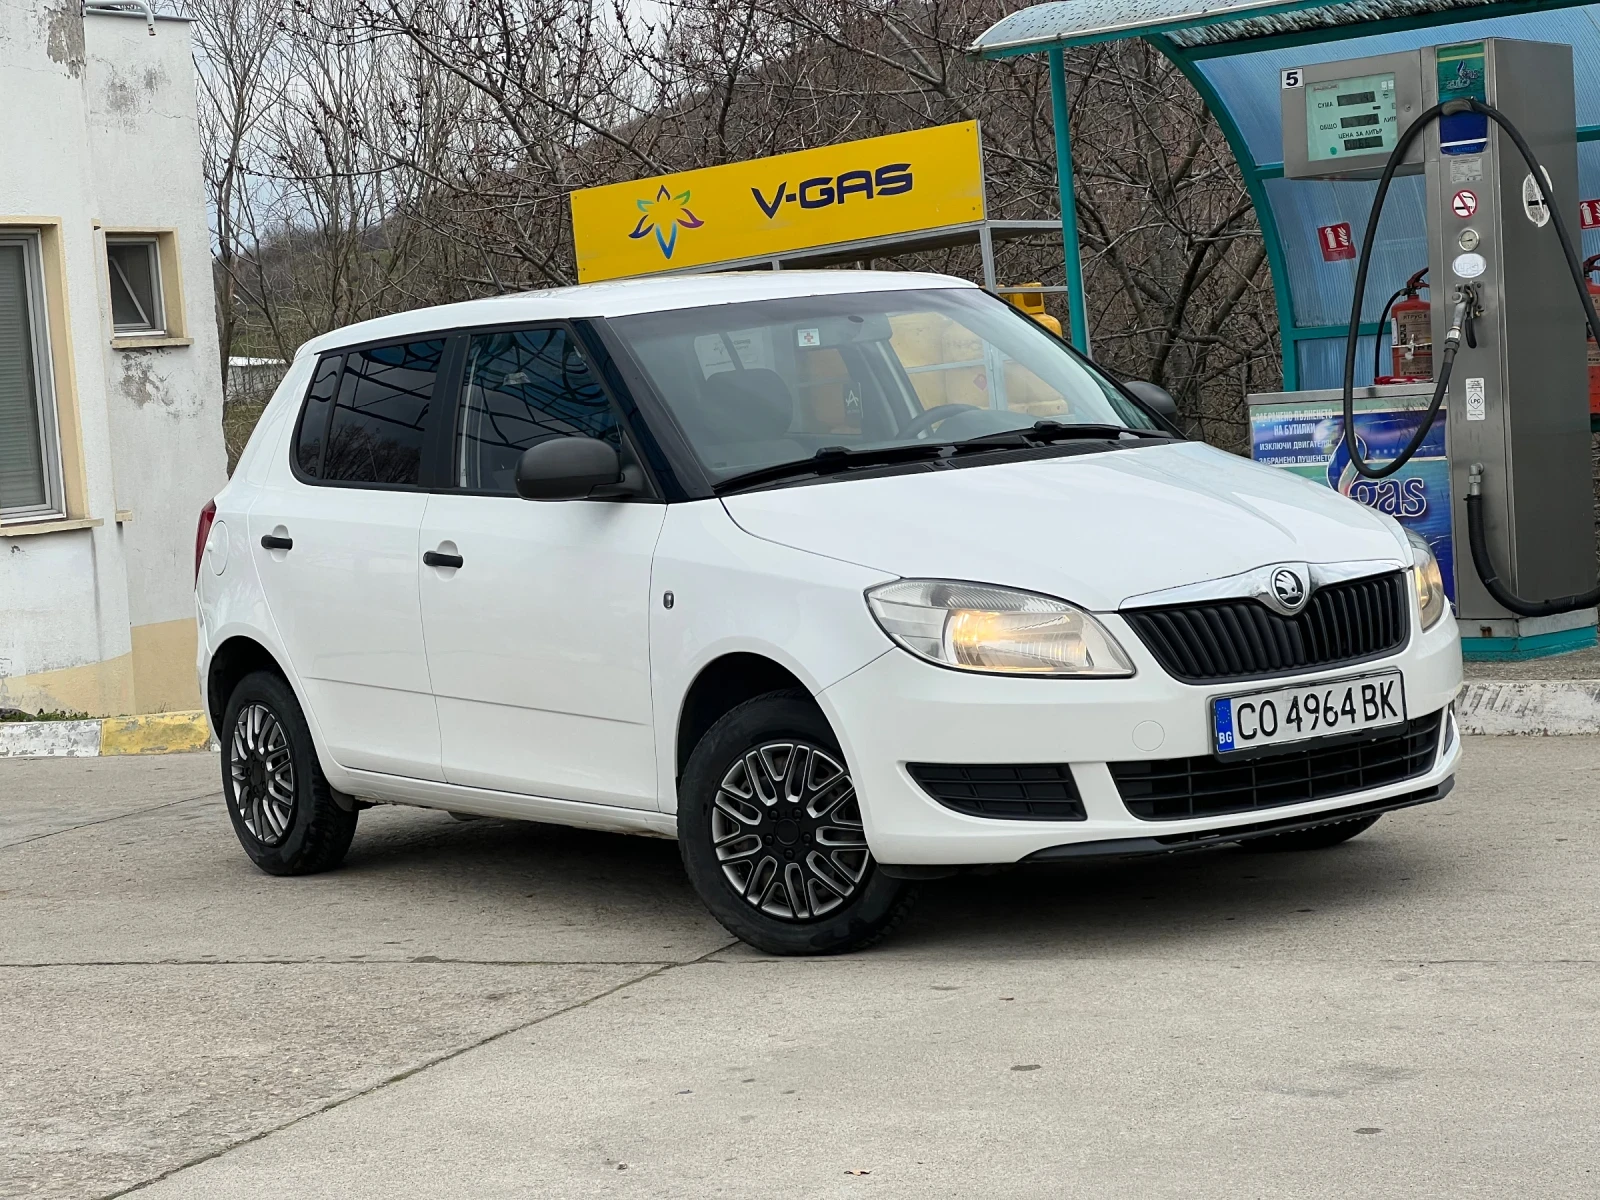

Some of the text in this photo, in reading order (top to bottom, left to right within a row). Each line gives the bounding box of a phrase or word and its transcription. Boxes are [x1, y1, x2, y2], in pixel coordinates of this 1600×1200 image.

[1286, 72, 1299, 86] 5
[1338, 131, 1354, 139] ЦЕНА
[1365, 128, 1383, 136] ЛИТЪР
[751, 163, 913, 219] V-GAS
[1256, 411, 1293, 423] ЗАБРАНЕНО
[1274, 423, 1316, 436] НА БУТИЛКИ
[1260, 442, 1292, 450] ИЗКЛЮЧИ
[1237, 700, 1278, 740] CO
[1218, 731, 1232, 744] BG
